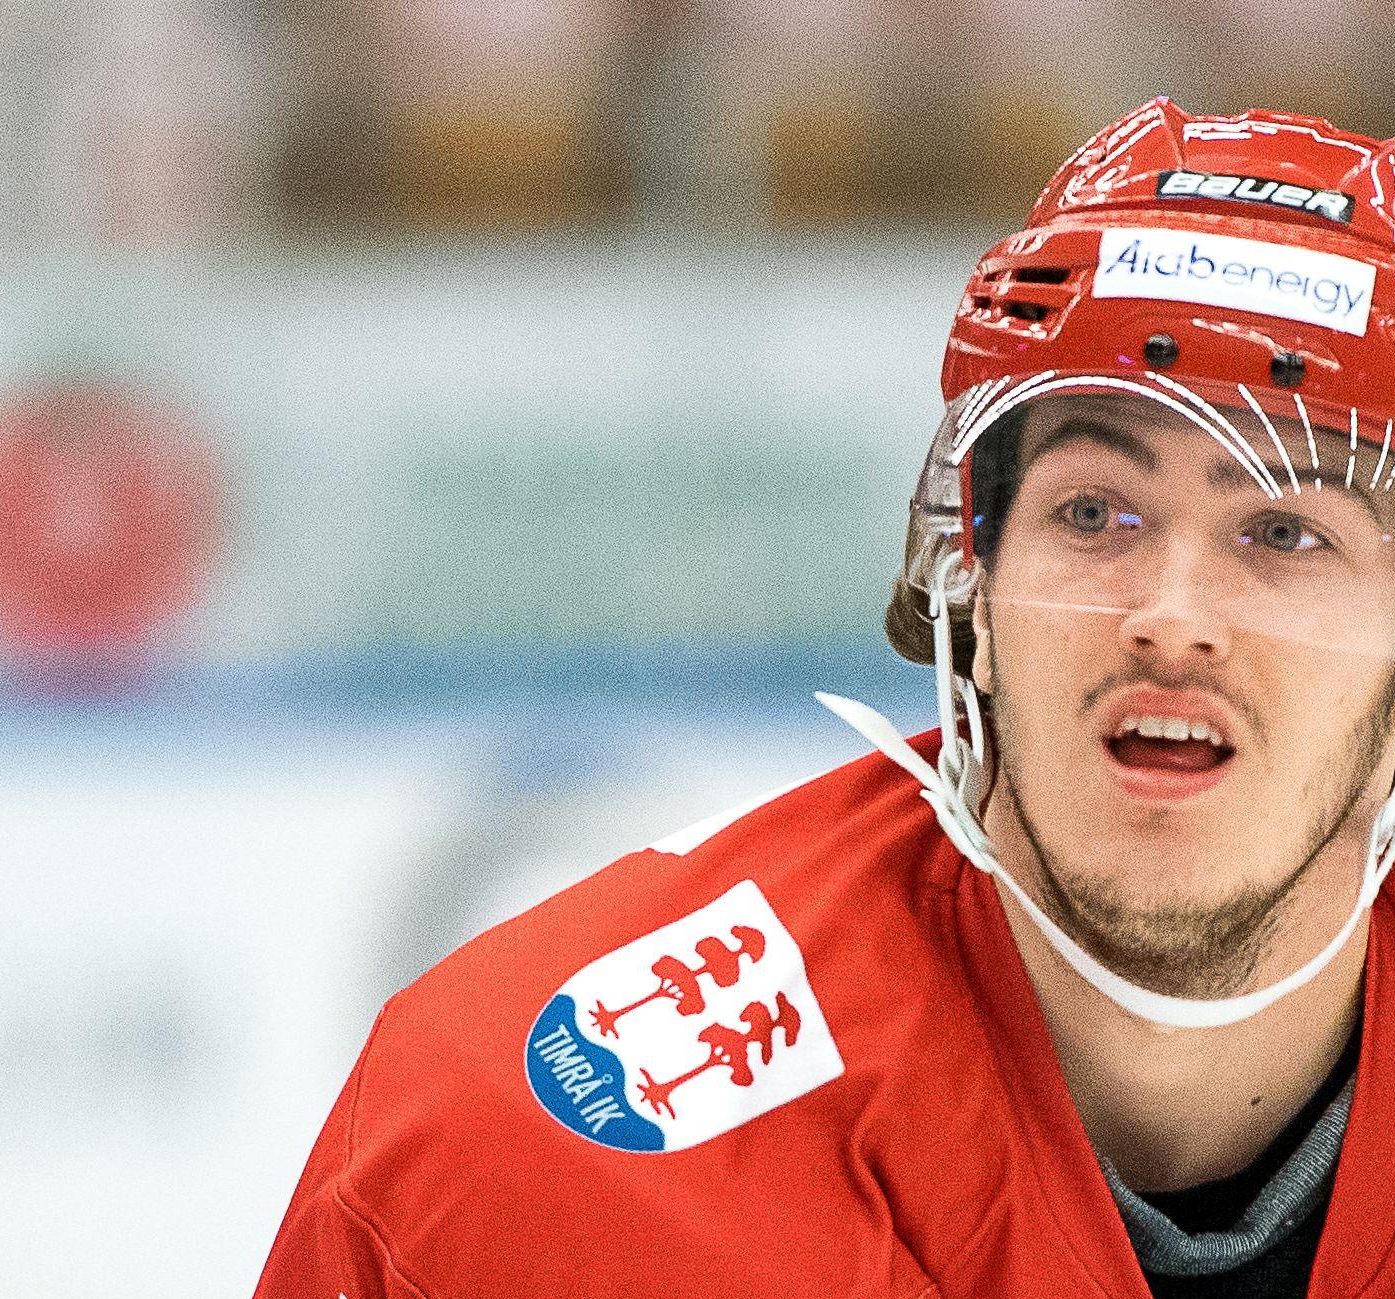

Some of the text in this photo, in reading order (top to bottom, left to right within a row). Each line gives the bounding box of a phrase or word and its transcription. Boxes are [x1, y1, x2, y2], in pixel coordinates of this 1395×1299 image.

[1161, 172, 1349, 222] BAUER
[533, 1023, 626, 1135] TIMRÅ IK
